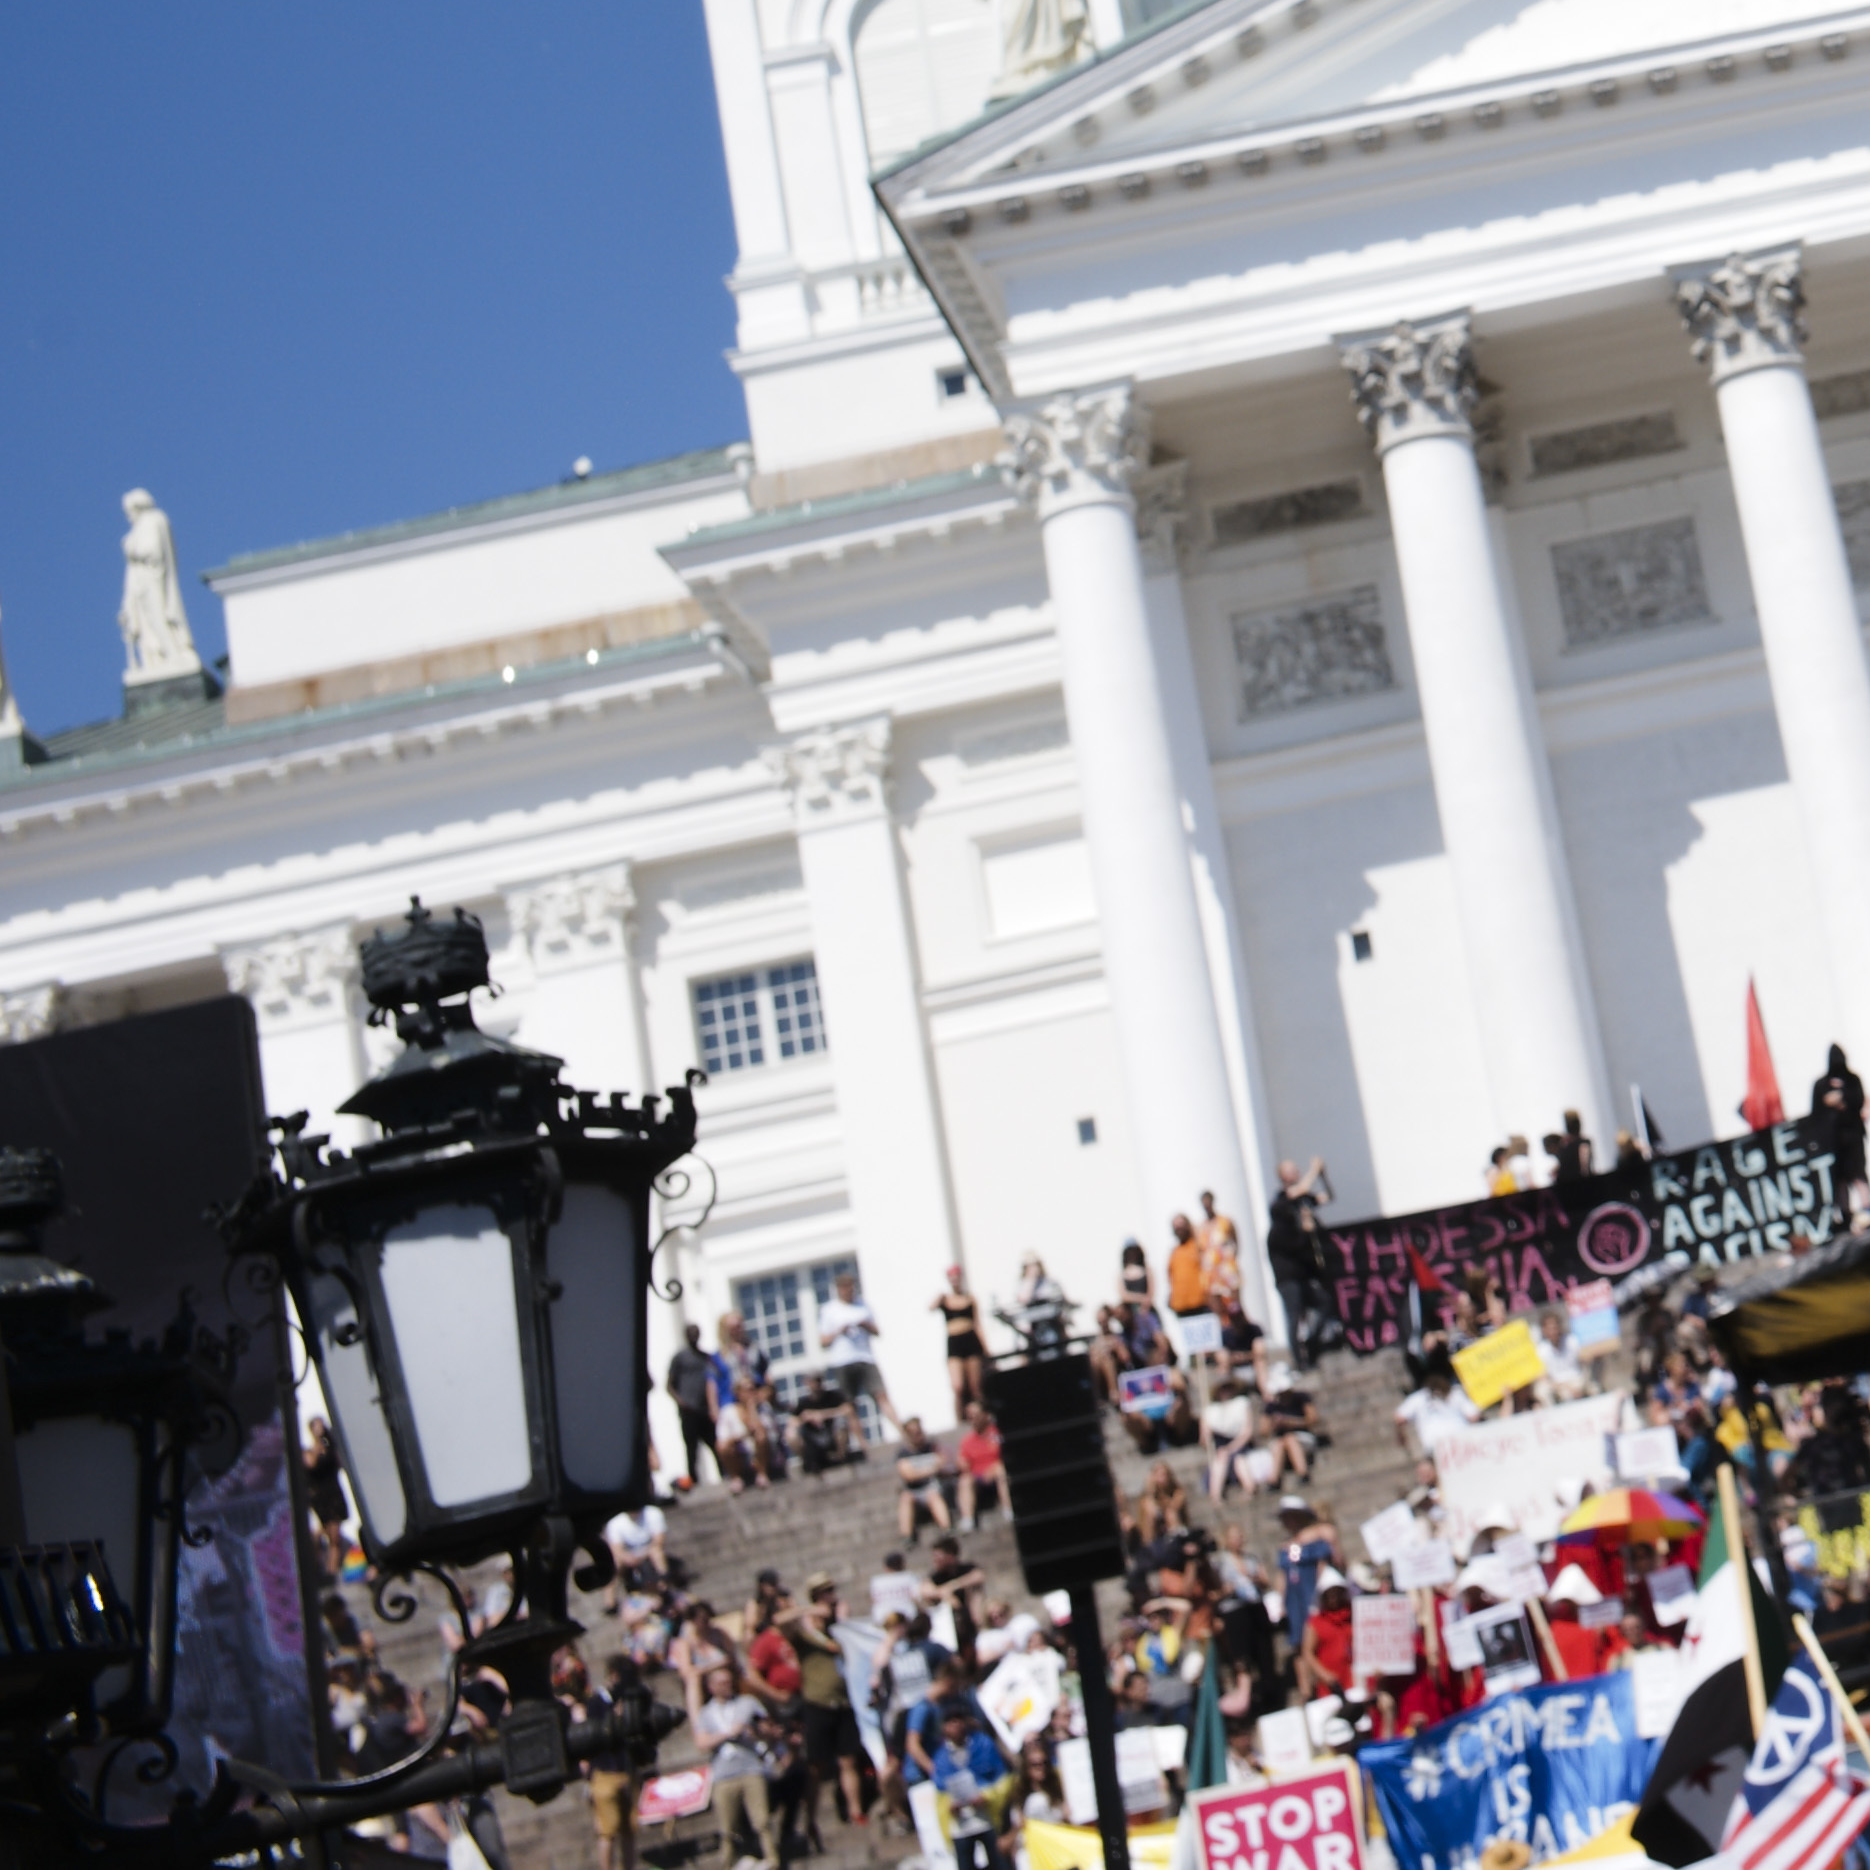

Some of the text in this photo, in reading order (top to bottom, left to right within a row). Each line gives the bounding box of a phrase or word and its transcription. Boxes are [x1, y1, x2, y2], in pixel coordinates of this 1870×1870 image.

[1652, 1122, 1806, 1201] RAGE
[1662, 1152, 1836, 1251] AGAINST
[1204, 1785, 1347, 1859] STOP
[1492, 1763, 1532, 1825] IS
